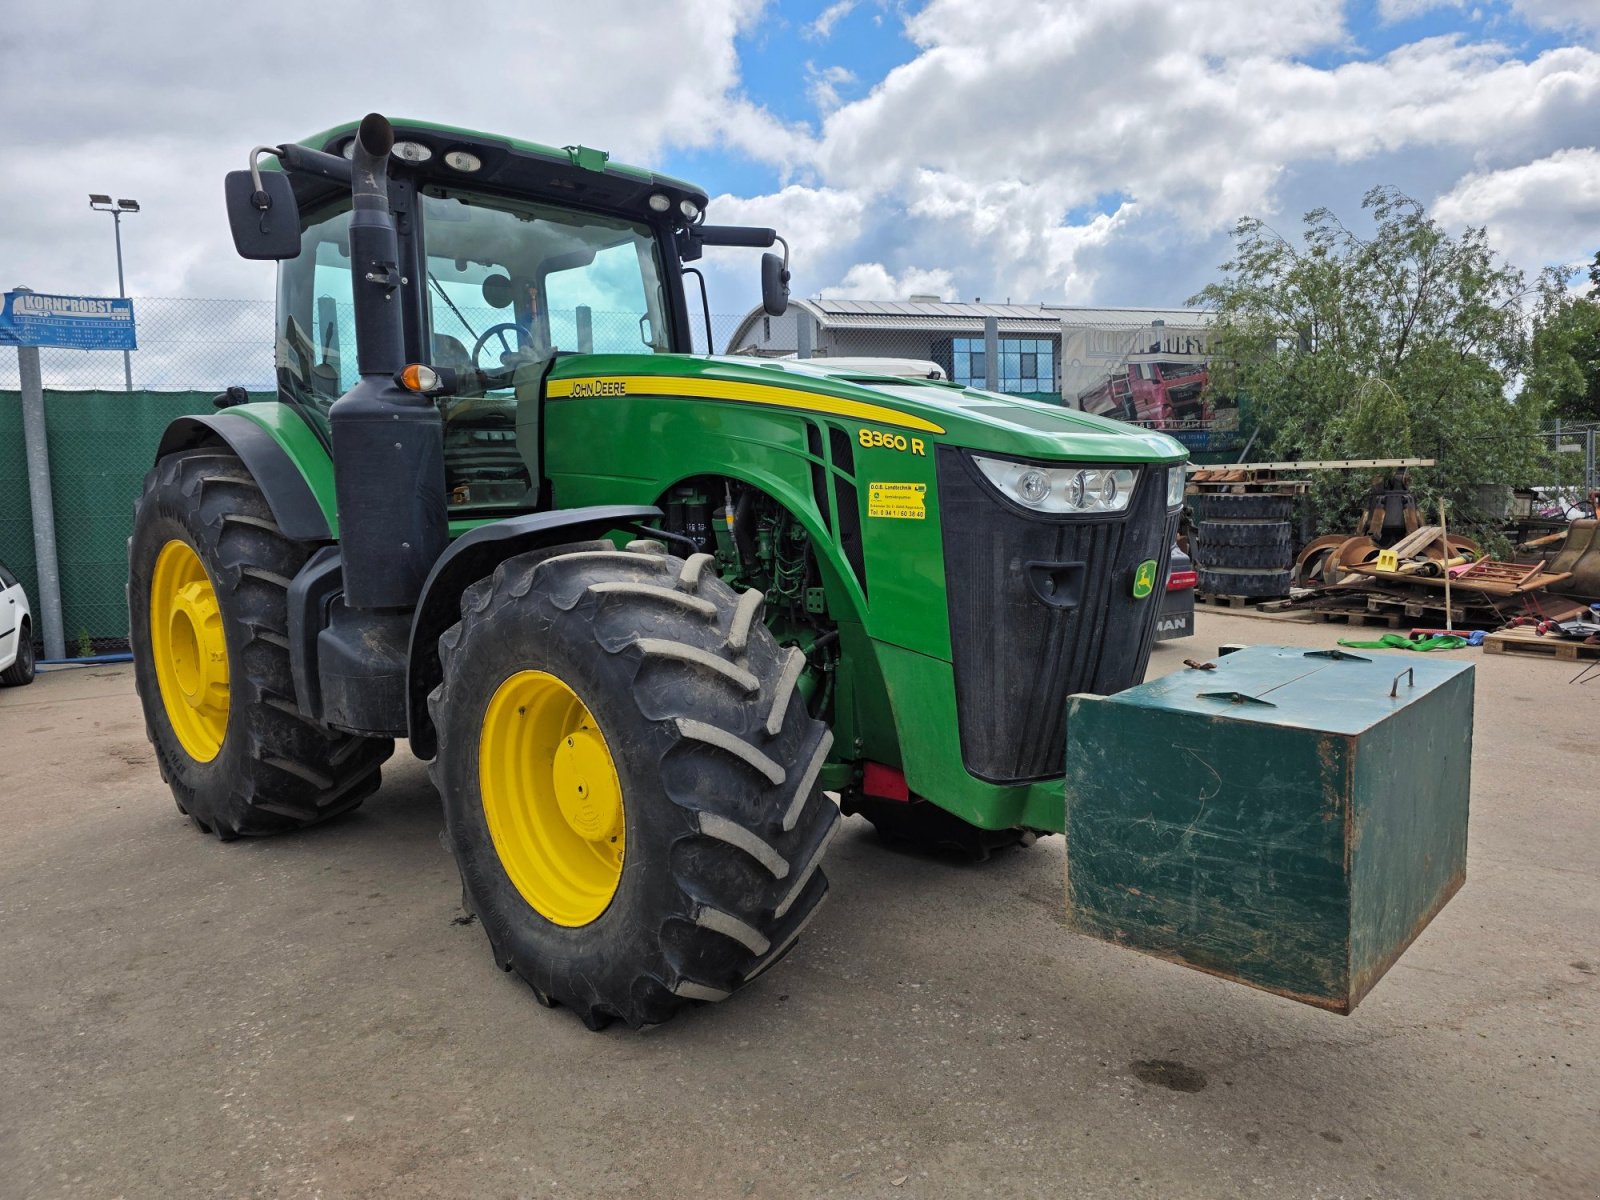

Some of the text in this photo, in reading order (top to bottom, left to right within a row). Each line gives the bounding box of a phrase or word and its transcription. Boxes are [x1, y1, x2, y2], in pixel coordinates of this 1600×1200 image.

[25, 296, 112, 313] KORNPROBST
[570, 380, 626, 396] JOHN DEERE
[859, 429, 925, 456] 8360 R
